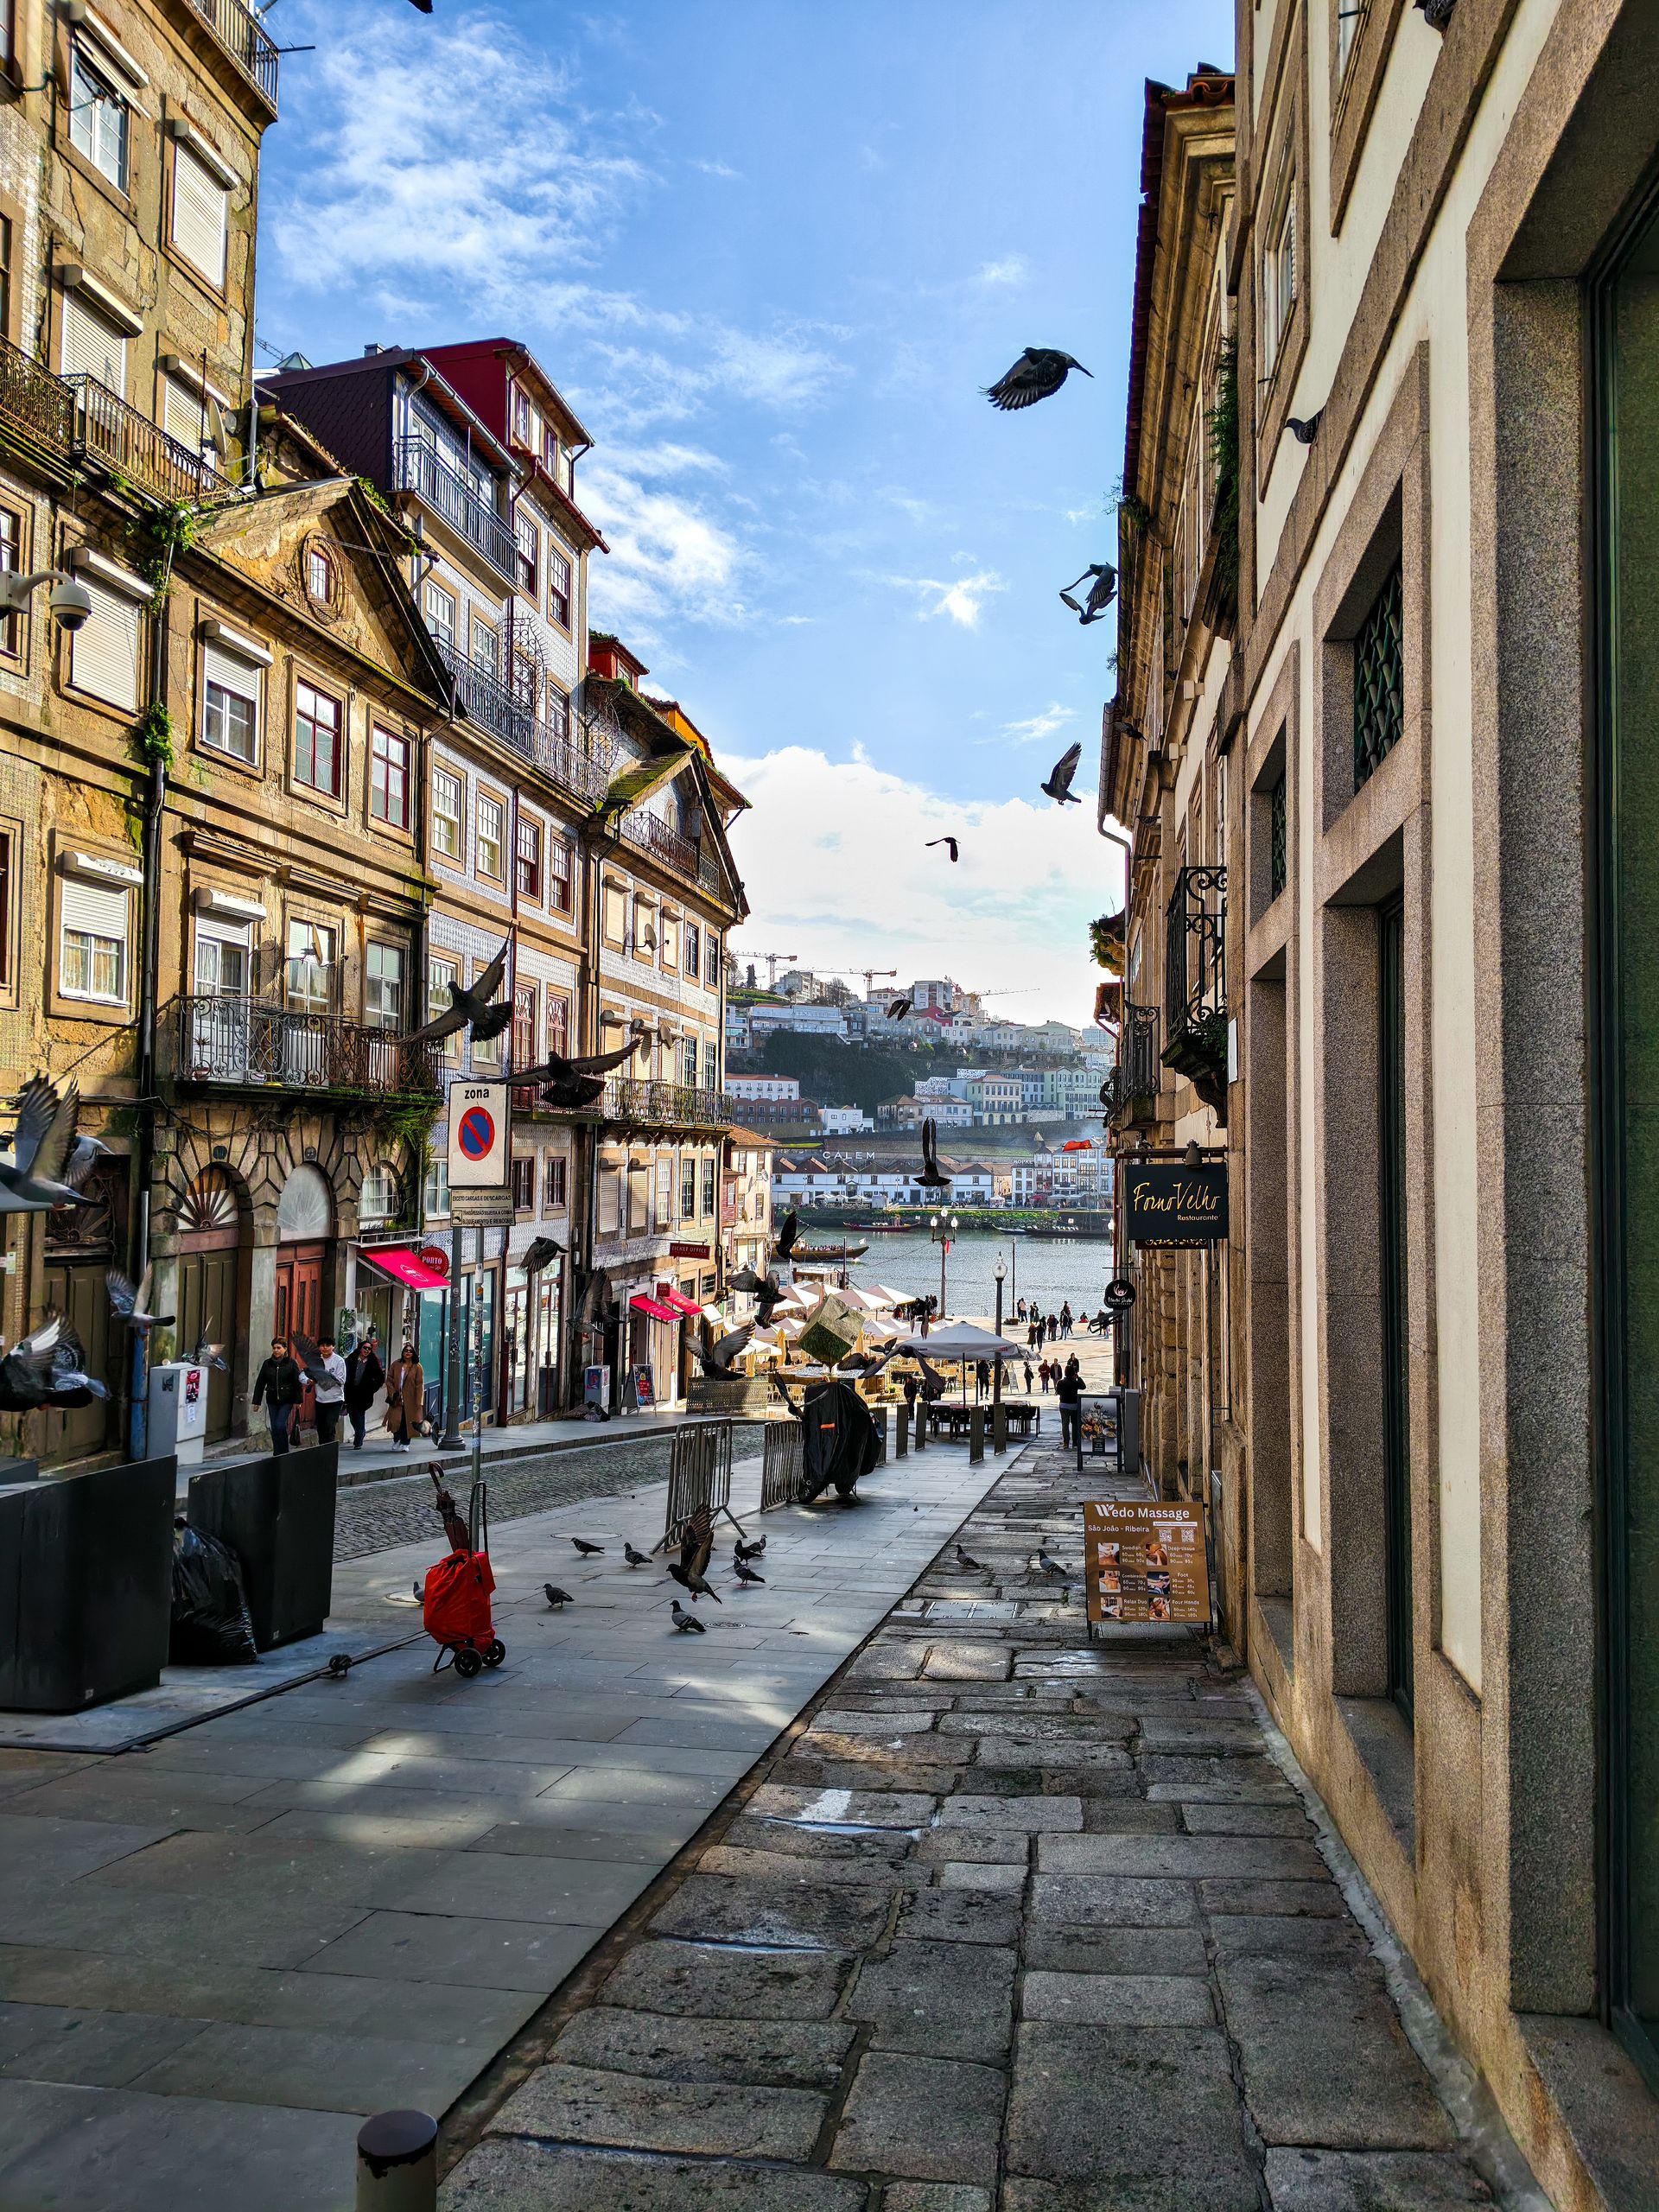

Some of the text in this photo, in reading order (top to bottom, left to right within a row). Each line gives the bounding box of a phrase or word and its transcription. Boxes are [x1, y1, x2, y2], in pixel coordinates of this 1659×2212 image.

[464, 1087, 490, 1099] zona
[1173, 1181, 1221, 1211] Velho
[1177, 1213, 1218, 1222] Restaurante
[422, 1255, 442, 1265] PORTO
[1094, 1503, 1190, 1521] Wedo Massage
